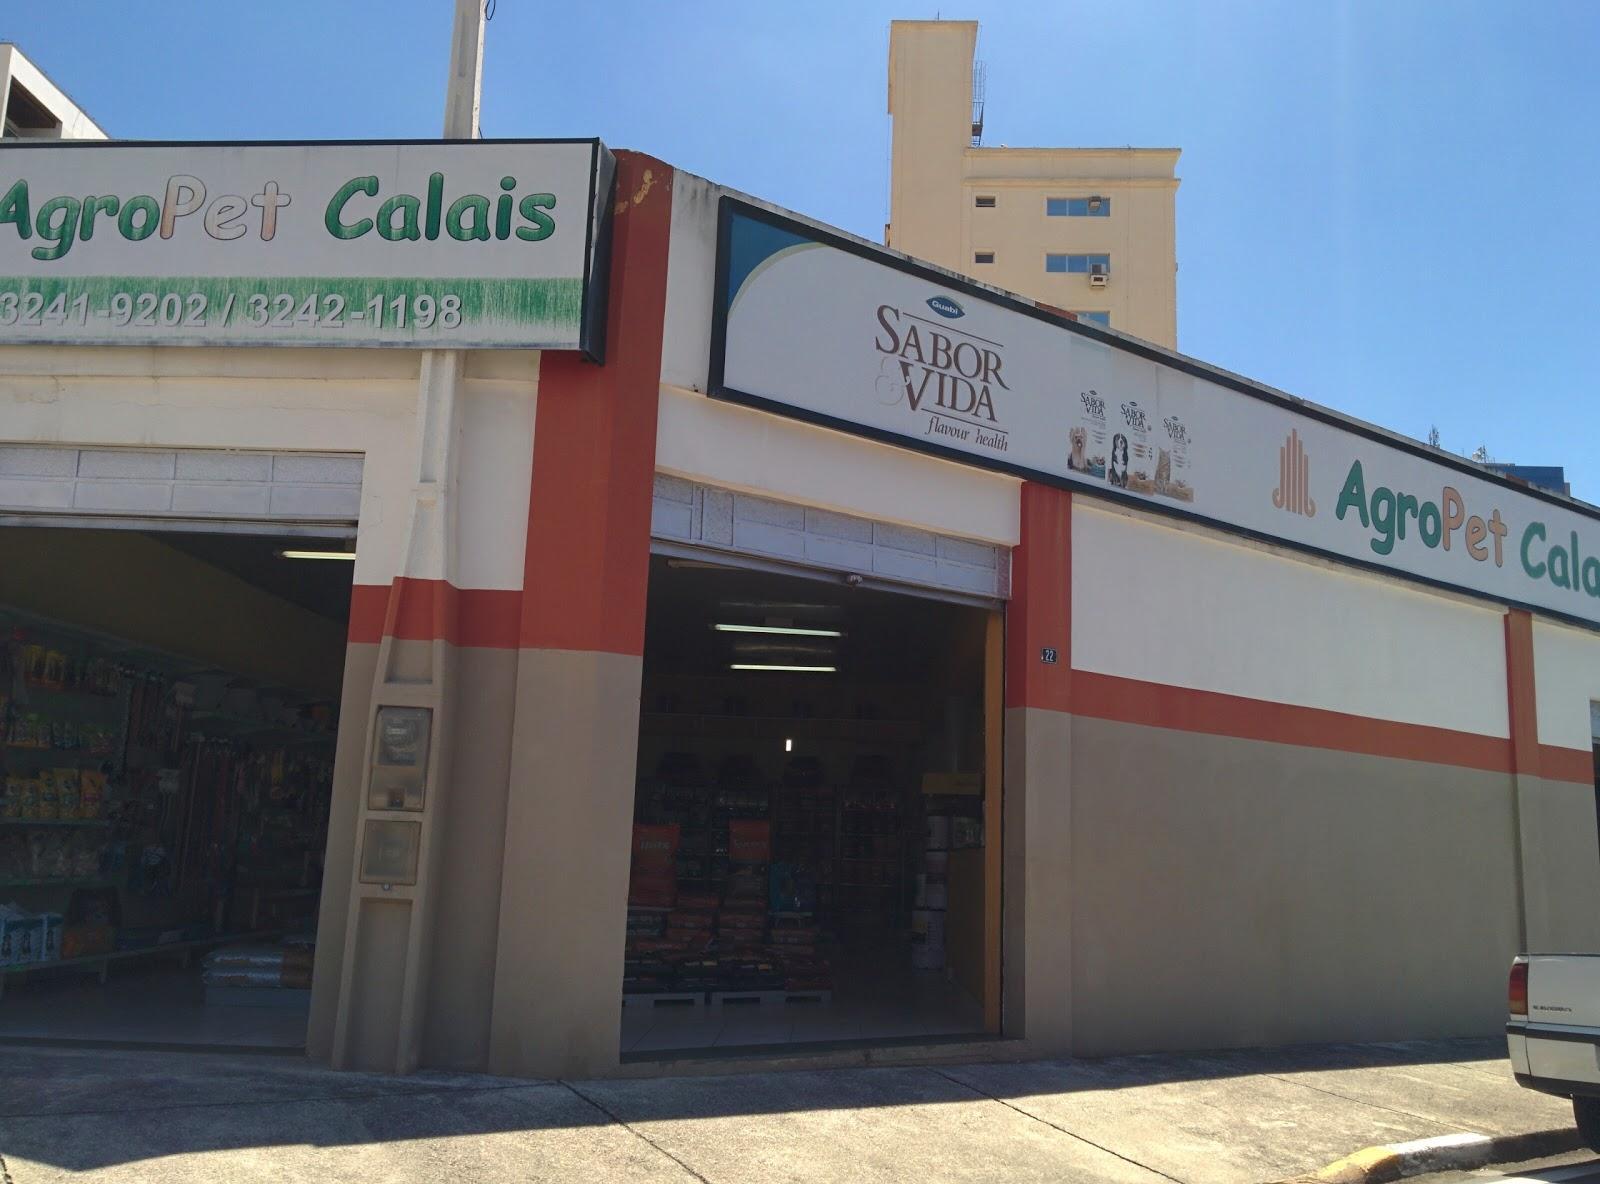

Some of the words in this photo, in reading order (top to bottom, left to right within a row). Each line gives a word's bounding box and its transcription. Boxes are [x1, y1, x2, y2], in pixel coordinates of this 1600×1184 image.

[0, 174, 291, 261] AgroPet
[324, 172, 556, 242] Calais
[0, 291, 208, 328] 3241-9202
[251, 293, 463, 329] 3242-1198
[931, 300, 959, 315] Guabi
[875, 305, 1010, 390] SABOR
[899, 360, 998, 423] VIDA
[925, 416, 970, 441] flavour
[975, 429, 1009, 452] health
[1336, 459, 1508, 568] AgroPet
[1045, 649, 1054, 662] 22
